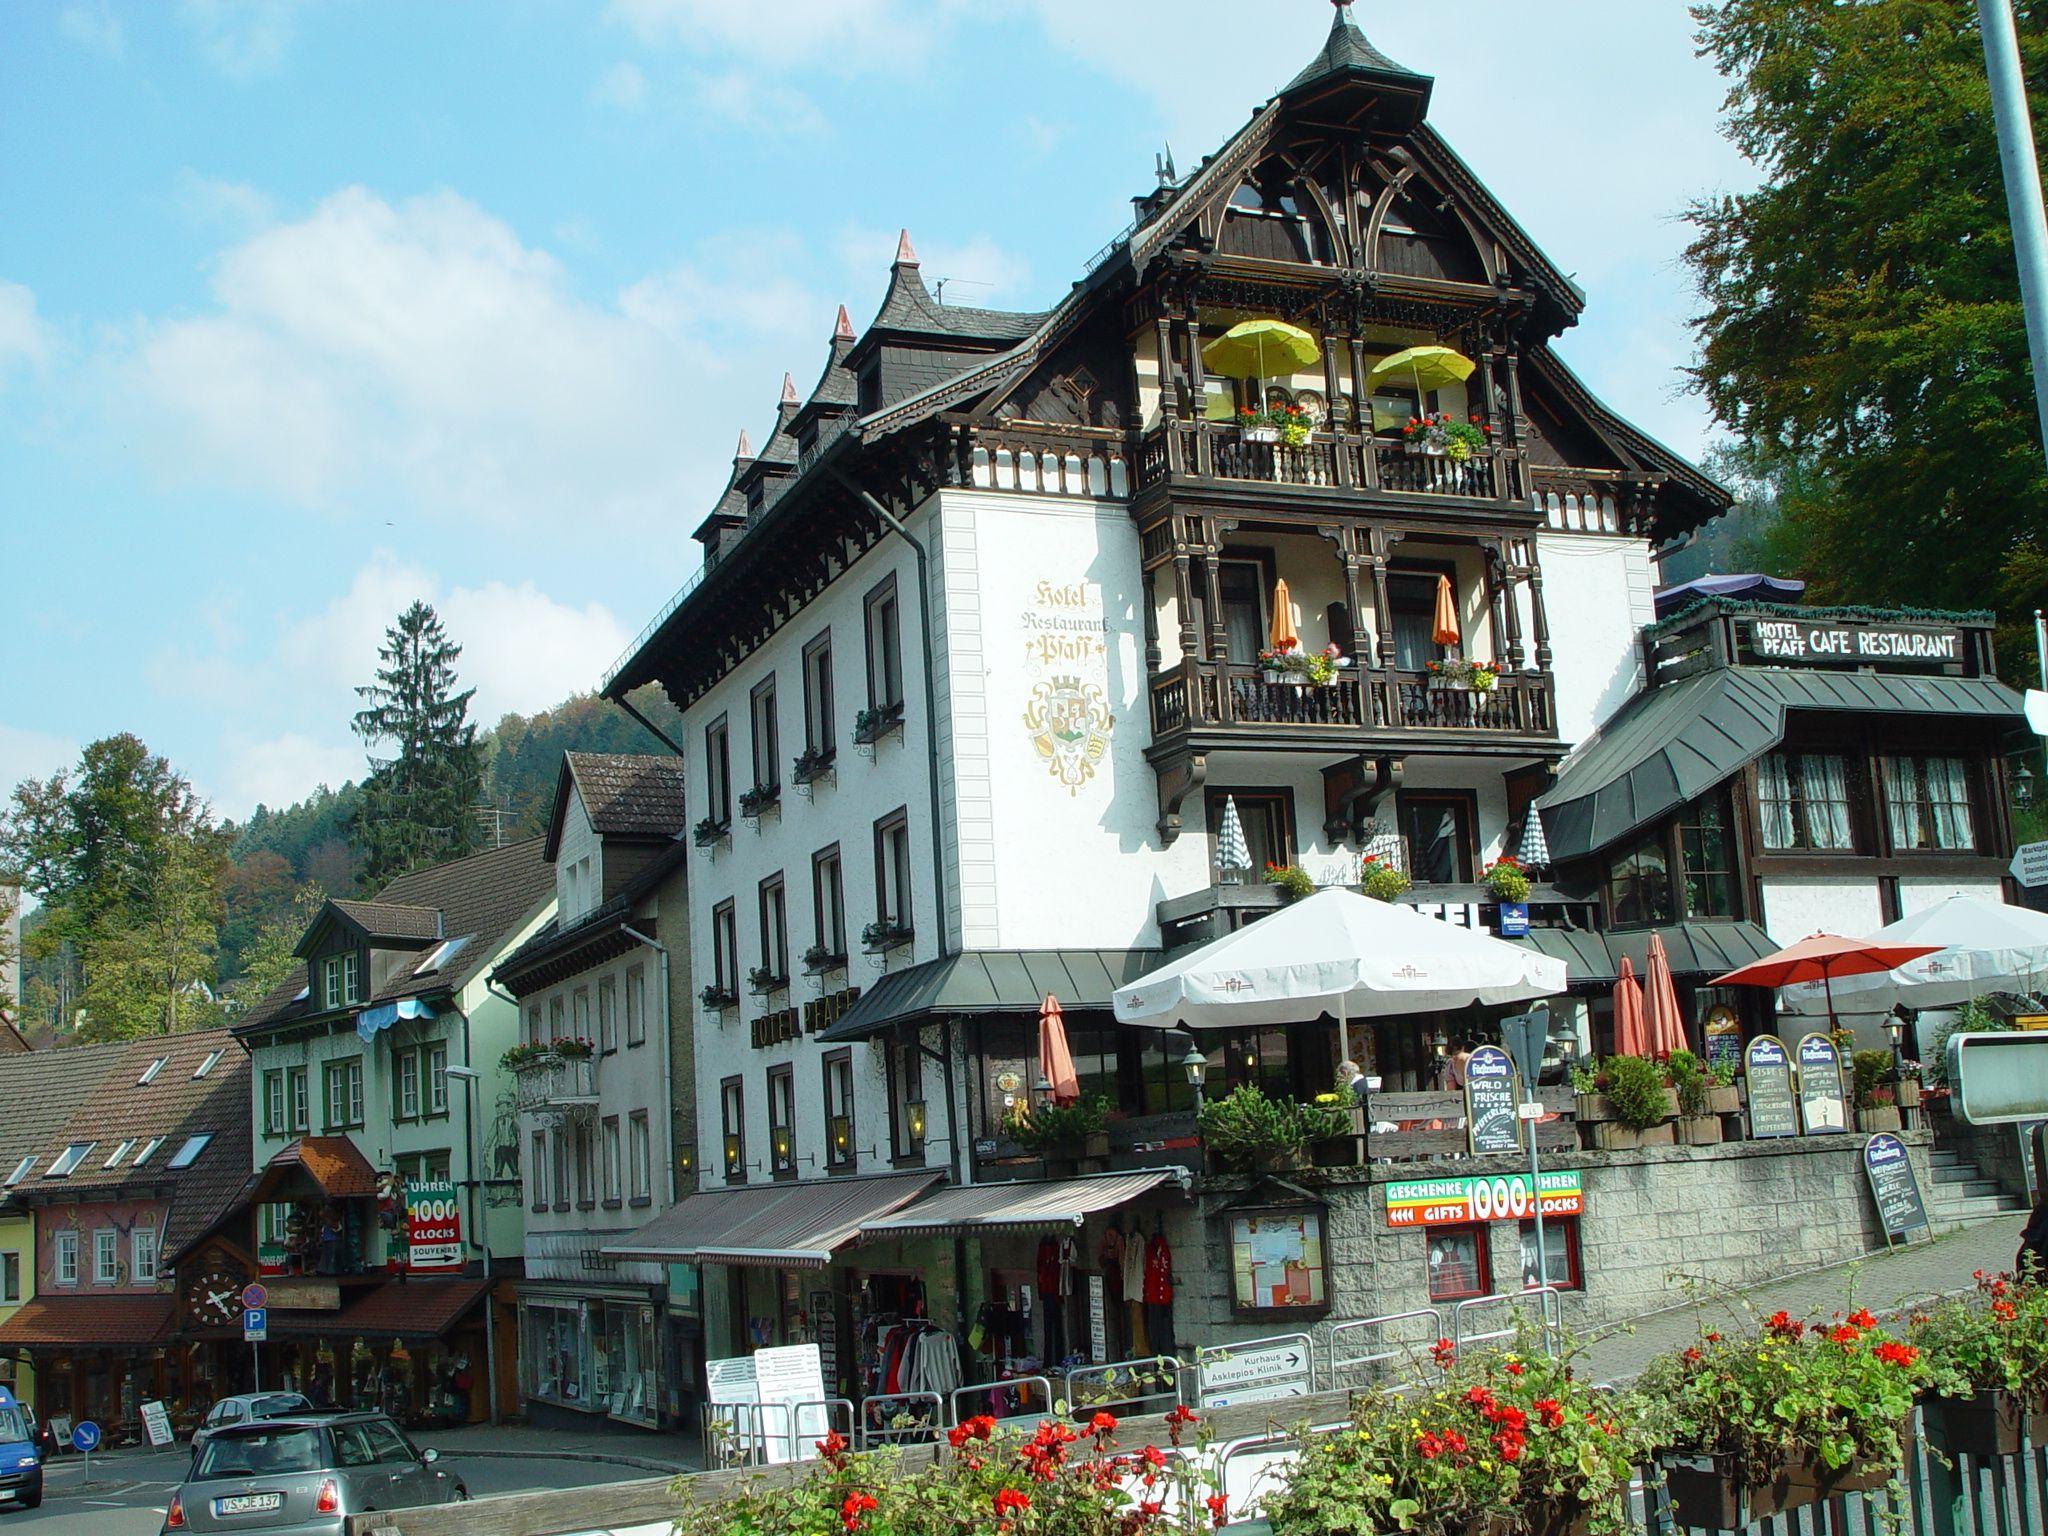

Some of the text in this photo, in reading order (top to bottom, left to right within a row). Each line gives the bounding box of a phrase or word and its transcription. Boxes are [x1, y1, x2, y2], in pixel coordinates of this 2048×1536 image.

[1036, 580, 1086, 608] Hotel
[1021, 611, 1110, 633] Restaurant
[1756, 621, 1802, 640] HOTEL
[1036, 634, 1094, 666] Pfaff
[1763, 638, 1806, 657] PFAFF
[1809, 630, 1956, 658] CAFE RESTAURANT
[1417, 903, 1491, 936] TEL
[751, 1007, 801, 1050] HOTEL
[1474, 1091, 1512, 1103] FRISCHE
[410, 1181, 454, 1193] UHREN
[1388, 1182, 1463, 1200] GESCHENKE
[1465, 1176, 1527, 1221] 1000
[412, 1198, 456, 1223] 1000
[1424, 1205, 1464, 1221] GIFTS
[413, 1228, 455, 1240] CLOCKS
[413, 1246, 458, 1256] SOUVENIRS
[249, 1311, 261, 1328] P
[1244, 1353, 1281, 1366] Kurhaus
[1211, 1363, 1283, 1382] Asklepios Klinik
[224, 1499, 238, 1510] VS
[260, 1494, 279, 1507] 137
